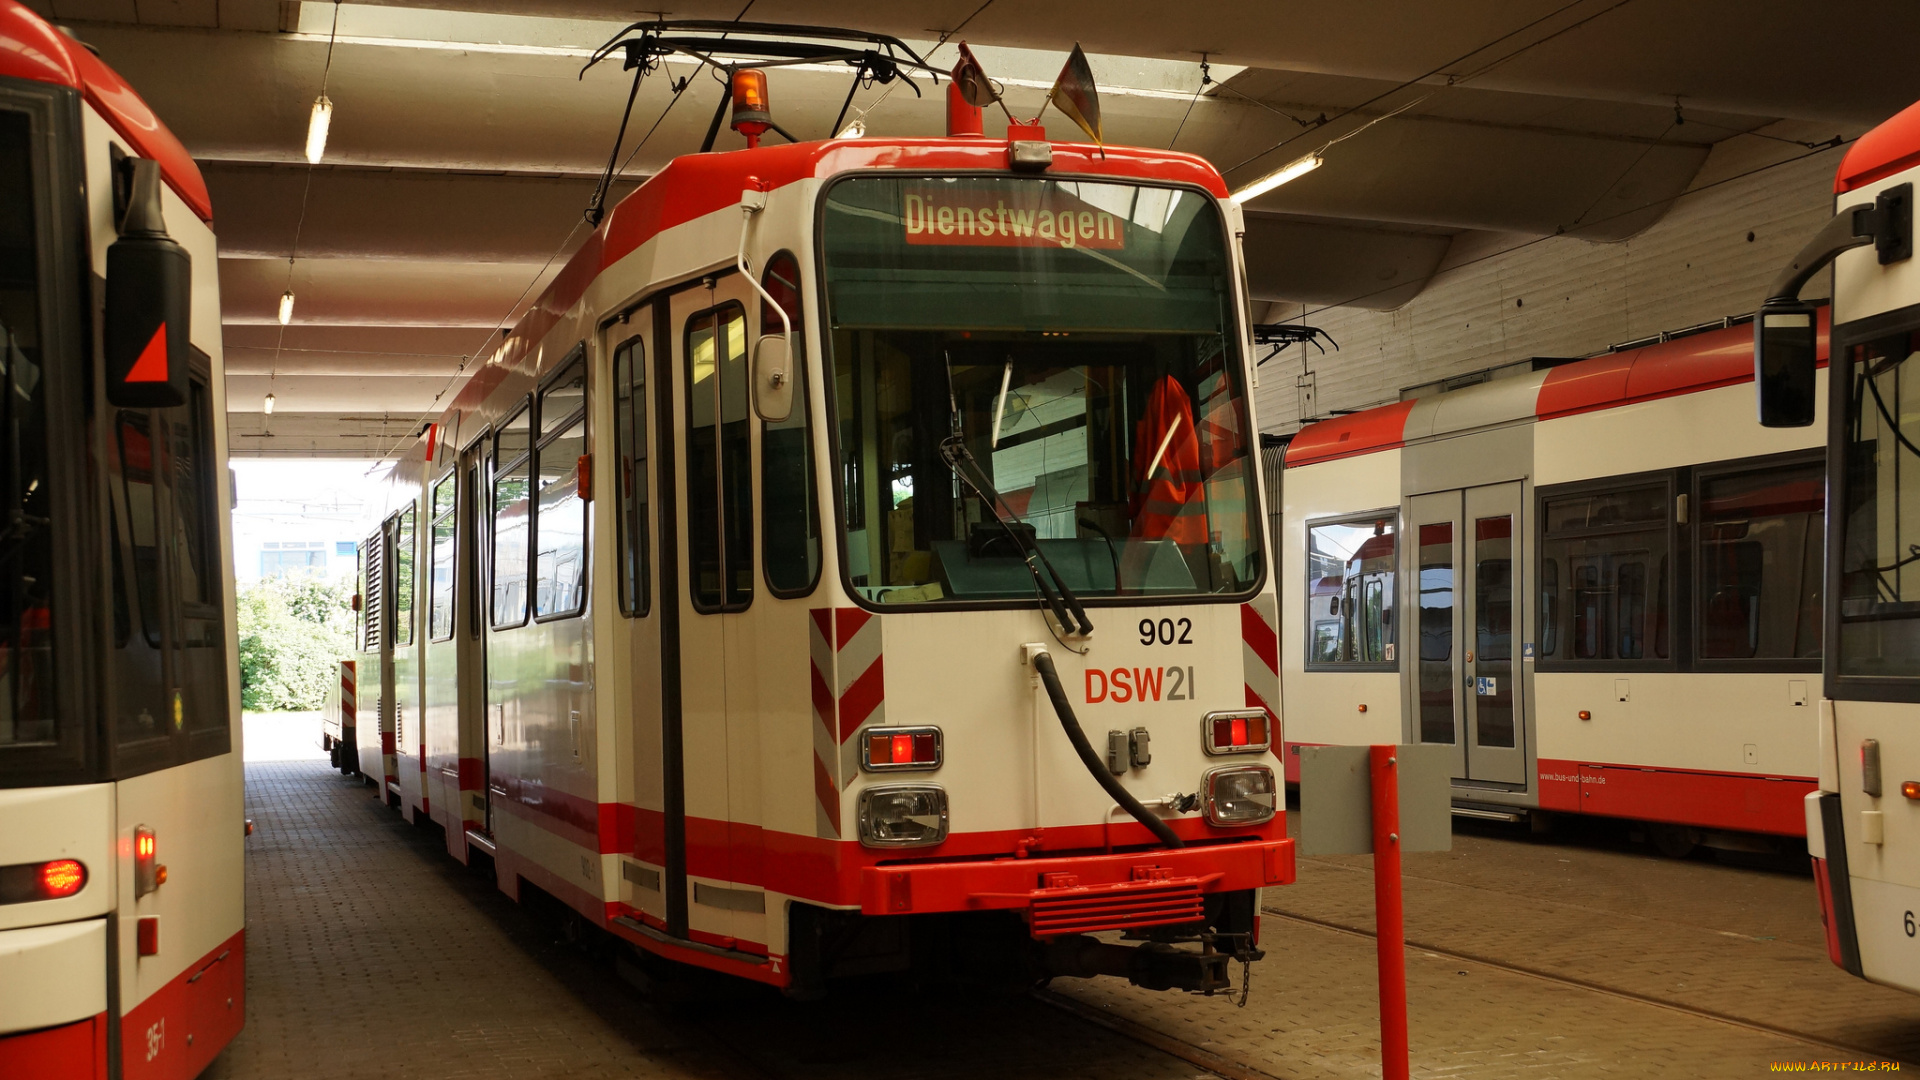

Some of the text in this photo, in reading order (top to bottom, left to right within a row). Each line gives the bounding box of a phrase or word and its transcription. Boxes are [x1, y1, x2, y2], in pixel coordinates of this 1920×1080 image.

[906, 194, 1115, 249] Dienstwagen
[1138, 617, 1193, 646] 902
[1085, 665, 1195, 704] DSW21
[1540, 773, 1606, 784] www.bus-und-bahn.de
[147, 1017, 165, 1062] 35-1
